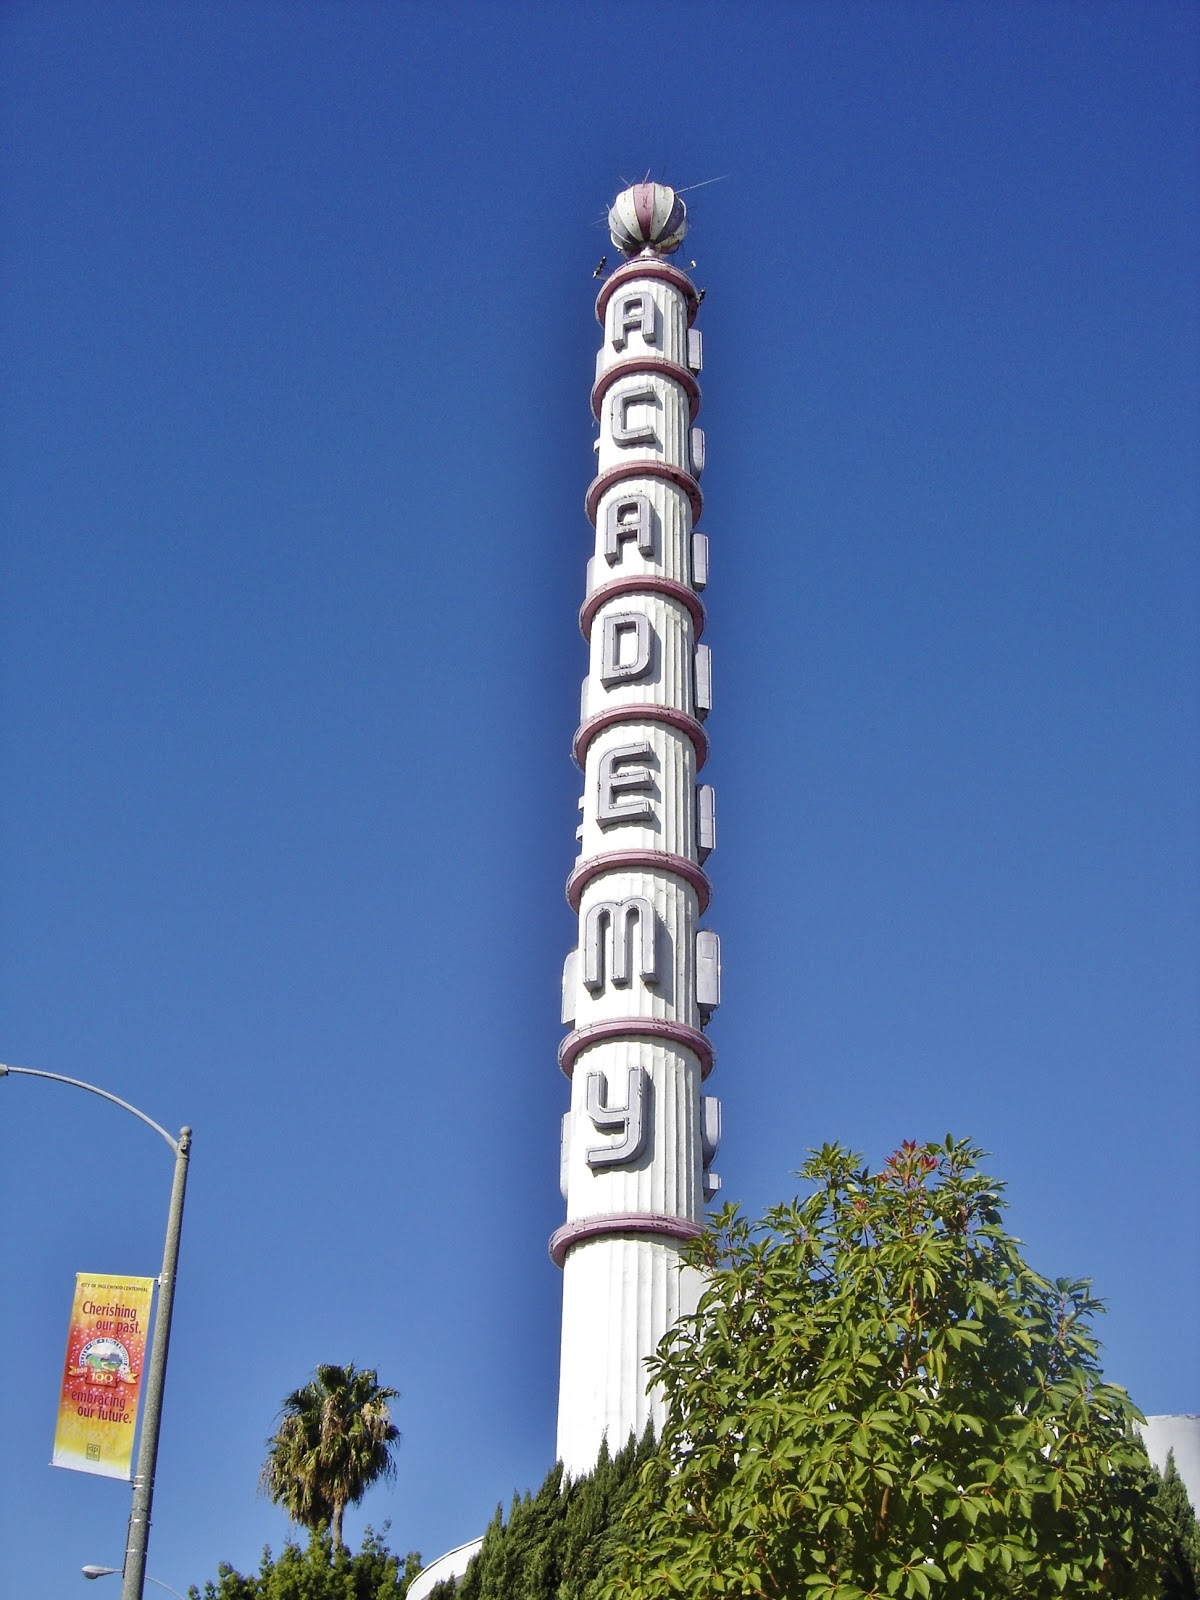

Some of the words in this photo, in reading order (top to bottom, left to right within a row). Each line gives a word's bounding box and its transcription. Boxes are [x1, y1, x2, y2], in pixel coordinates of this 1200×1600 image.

[82, 1300, 137, 1322] Cherishing
[96, 1320, 114, 1331] our
[116, 1320, 142, 1335] past.
[90, 1372, 113, 1383] 100
[71, 1390, 126, 1412] embracing
[77, 1406, 96, 1419] our
[98, 1406, 132, 1424] future.
